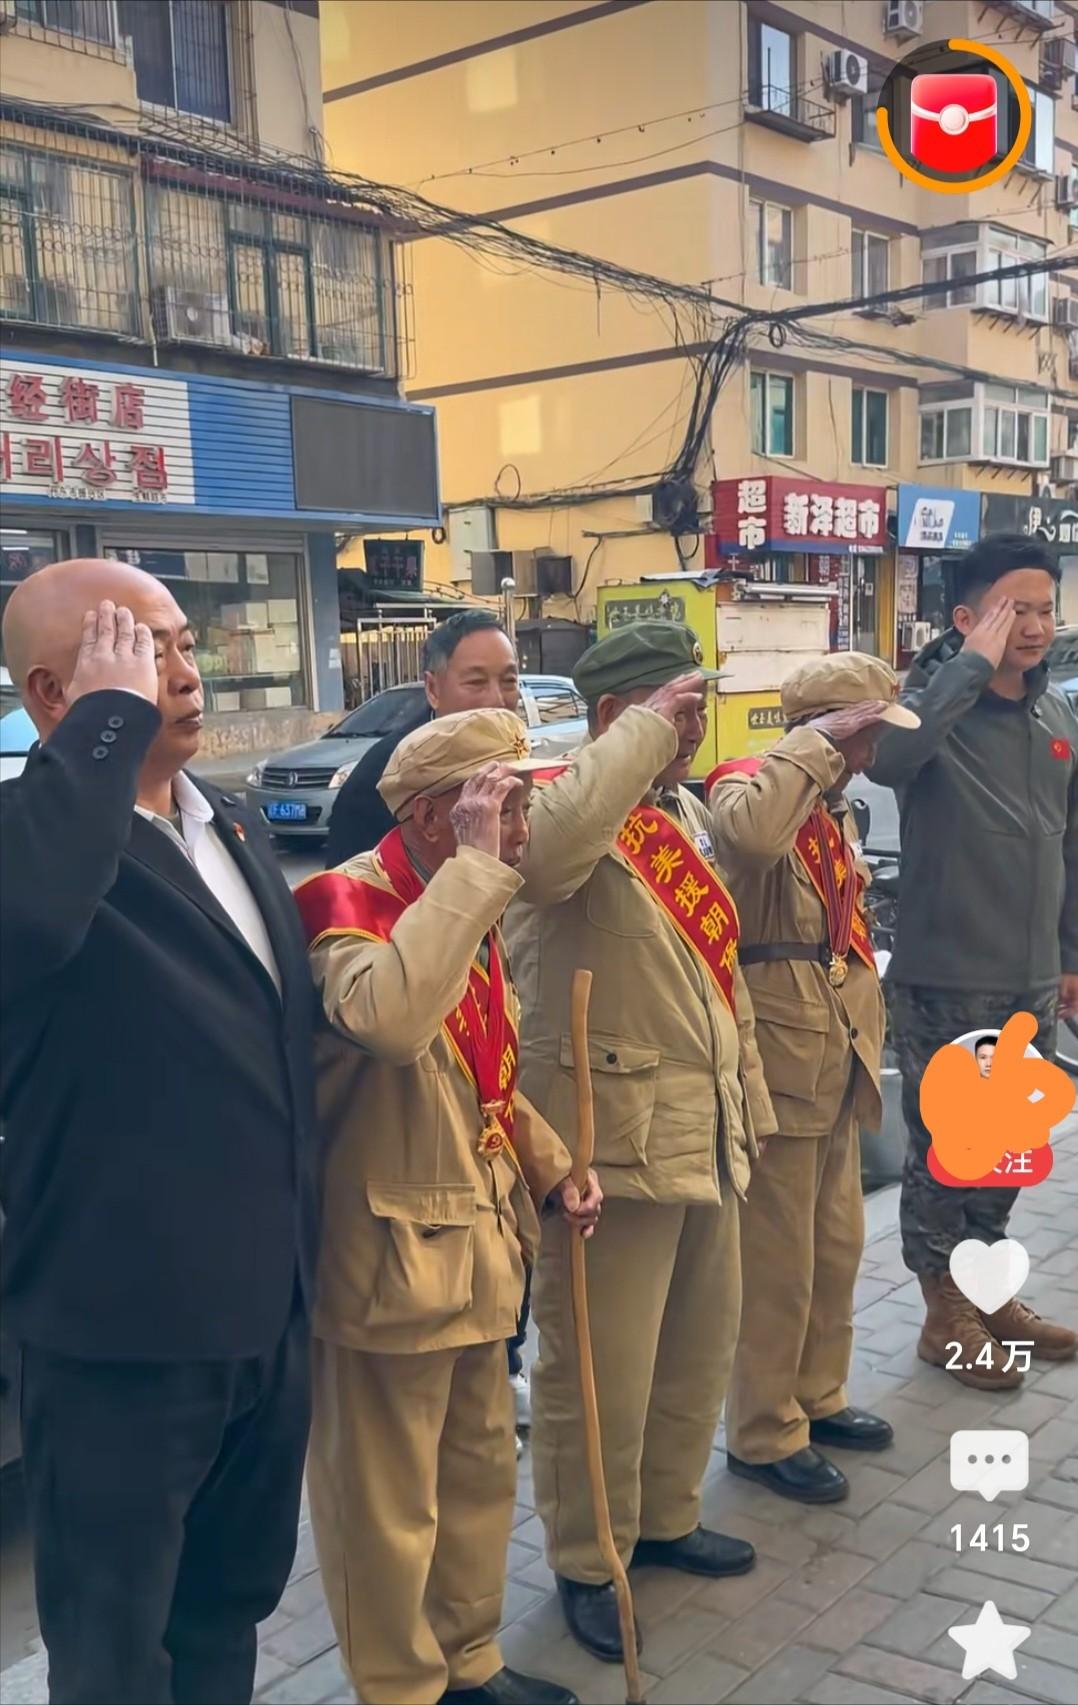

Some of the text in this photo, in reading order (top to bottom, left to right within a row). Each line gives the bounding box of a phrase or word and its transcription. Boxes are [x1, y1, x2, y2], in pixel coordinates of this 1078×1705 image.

[6, 373, 145, 430] 经街店
[738, 479, 767, 550] 超市
[783, 492, 880, 539] 新泽超市
